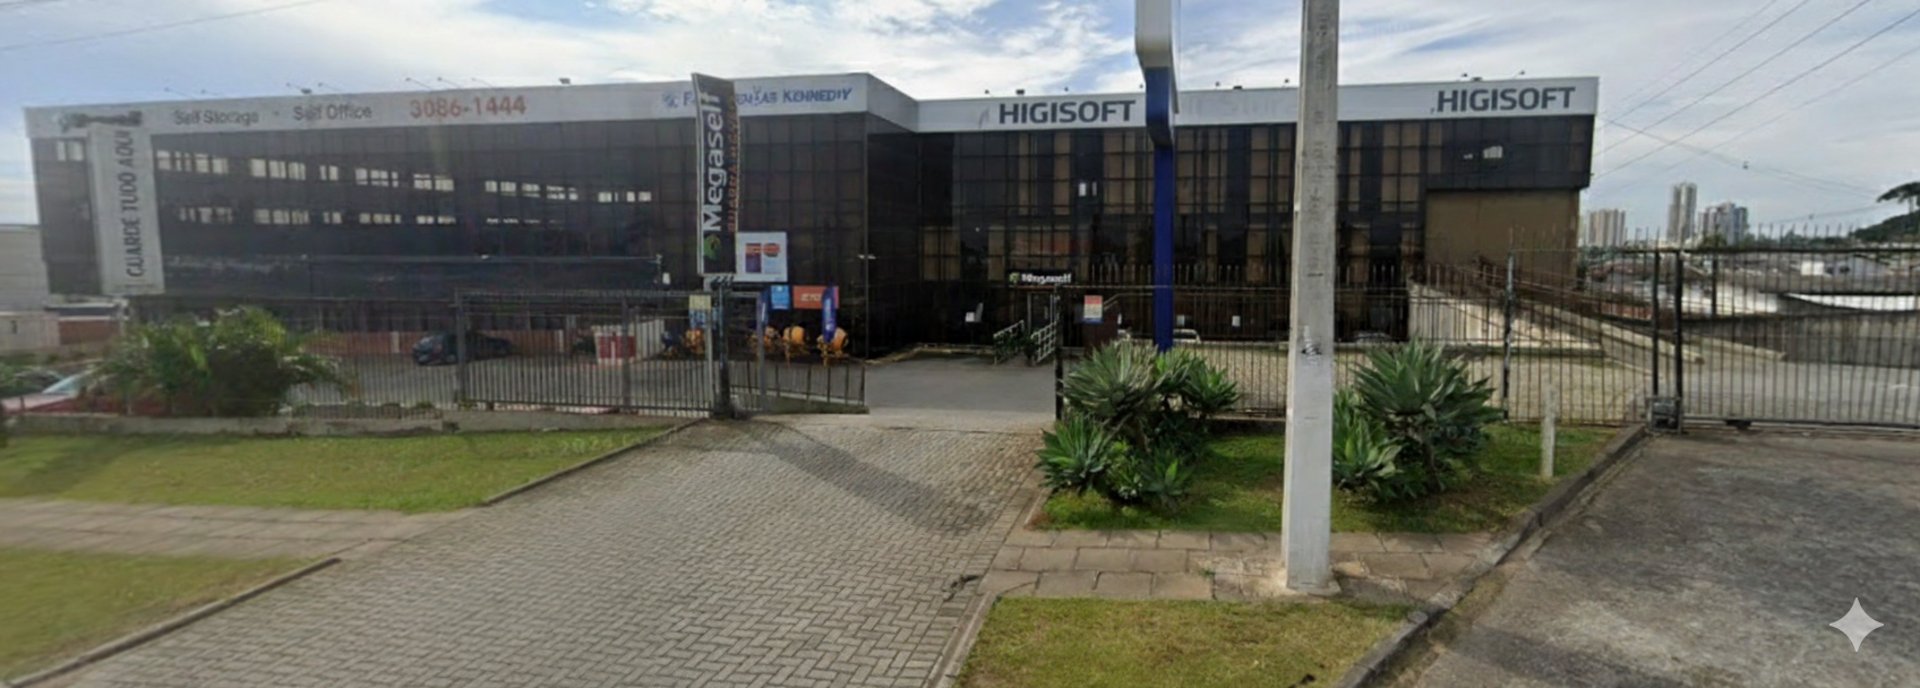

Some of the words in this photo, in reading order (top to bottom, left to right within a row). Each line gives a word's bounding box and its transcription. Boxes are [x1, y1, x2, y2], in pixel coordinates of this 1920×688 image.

[410, 95, 527, 119] 3086-1444
[1437, 87, 1576, 112] HIGISOFT
[293, 104, 323, 121] Self
[326, 103, 373, 120] Office
[999, 100, 1136, 124] HIGISOFT
[698, 92, 726, 232] Megaself
